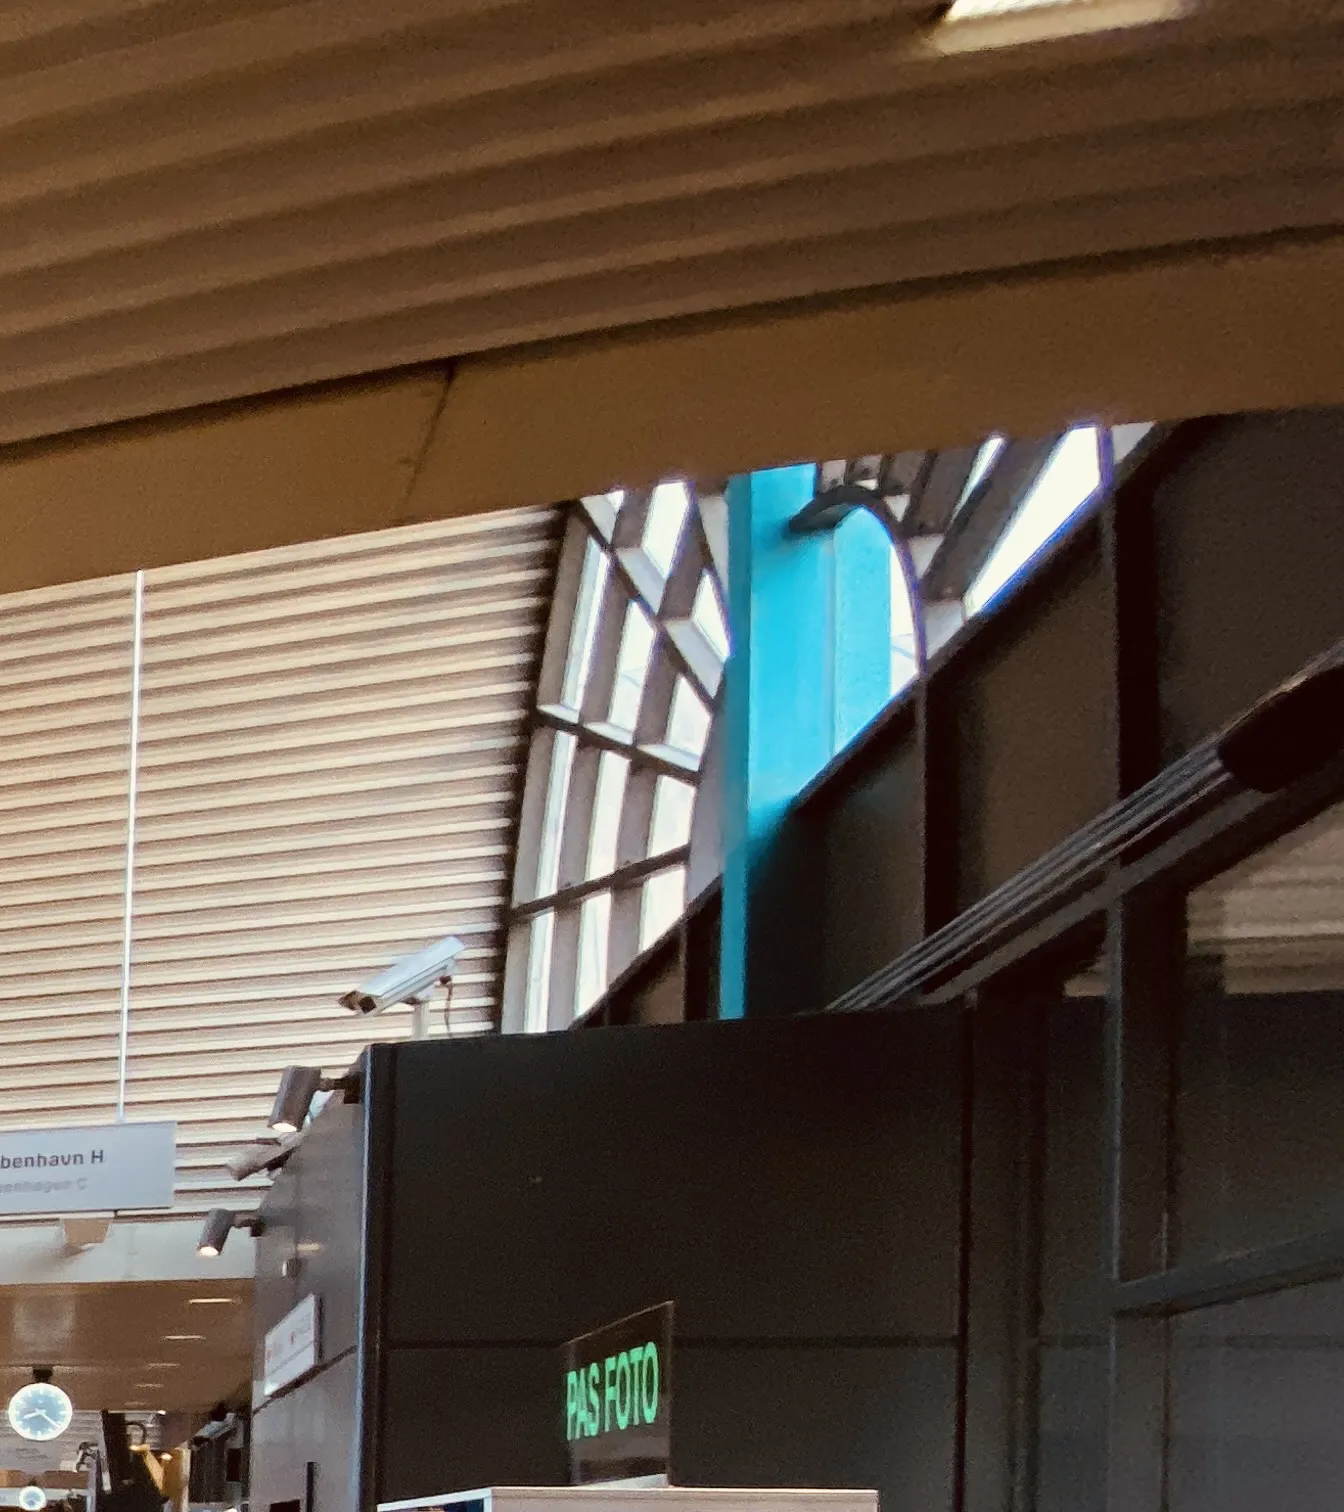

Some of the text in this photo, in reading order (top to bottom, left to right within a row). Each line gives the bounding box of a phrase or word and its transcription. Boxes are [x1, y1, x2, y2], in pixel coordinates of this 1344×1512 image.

[91, 1149, 104, 1165] H
[567, 1341, 659, 1441] PAS FOTO
